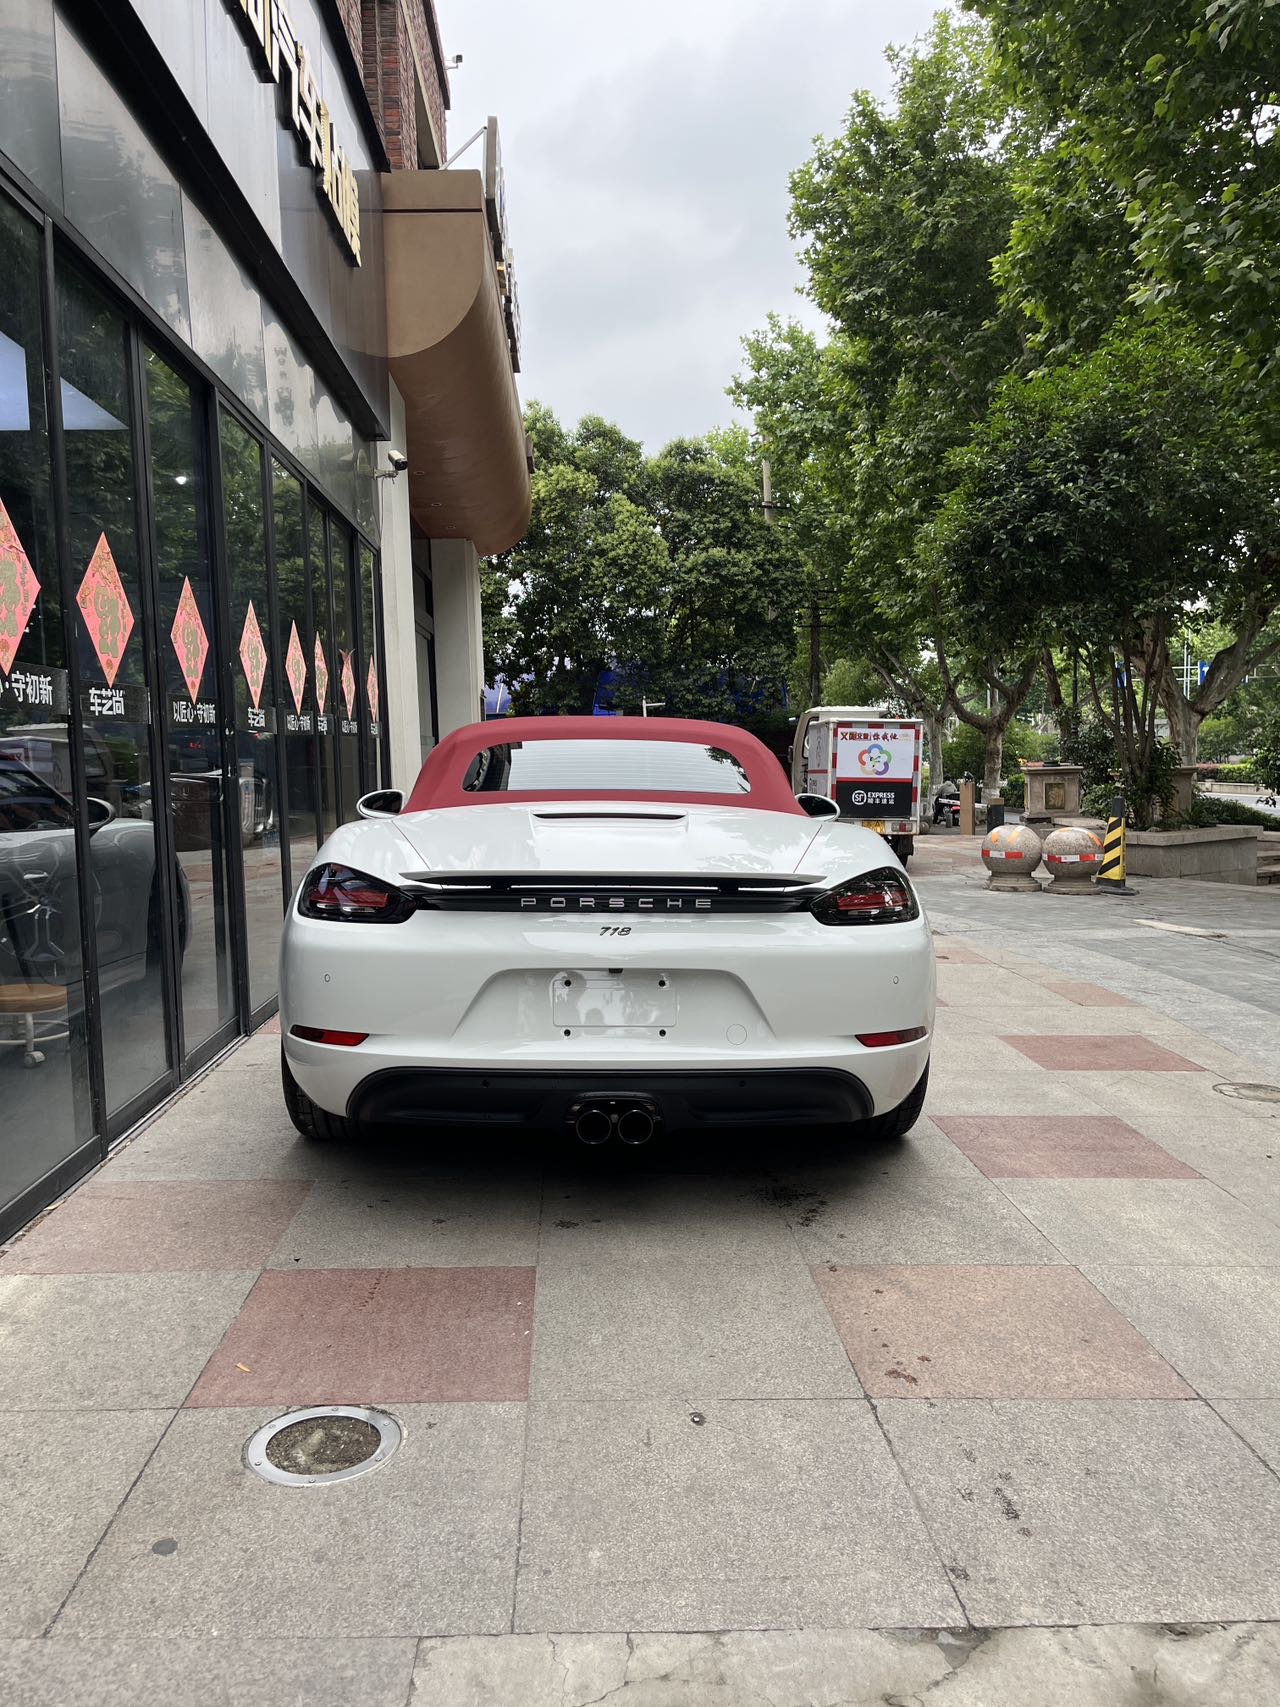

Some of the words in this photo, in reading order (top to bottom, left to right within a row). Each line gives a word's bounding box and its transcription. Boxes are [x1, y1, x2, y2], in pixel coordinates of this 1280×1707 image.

[867, 791, 895, 799] EXPRESS
[520, 897, 711, 909] PORSCHE
[600, 926, 632, 937] 718
